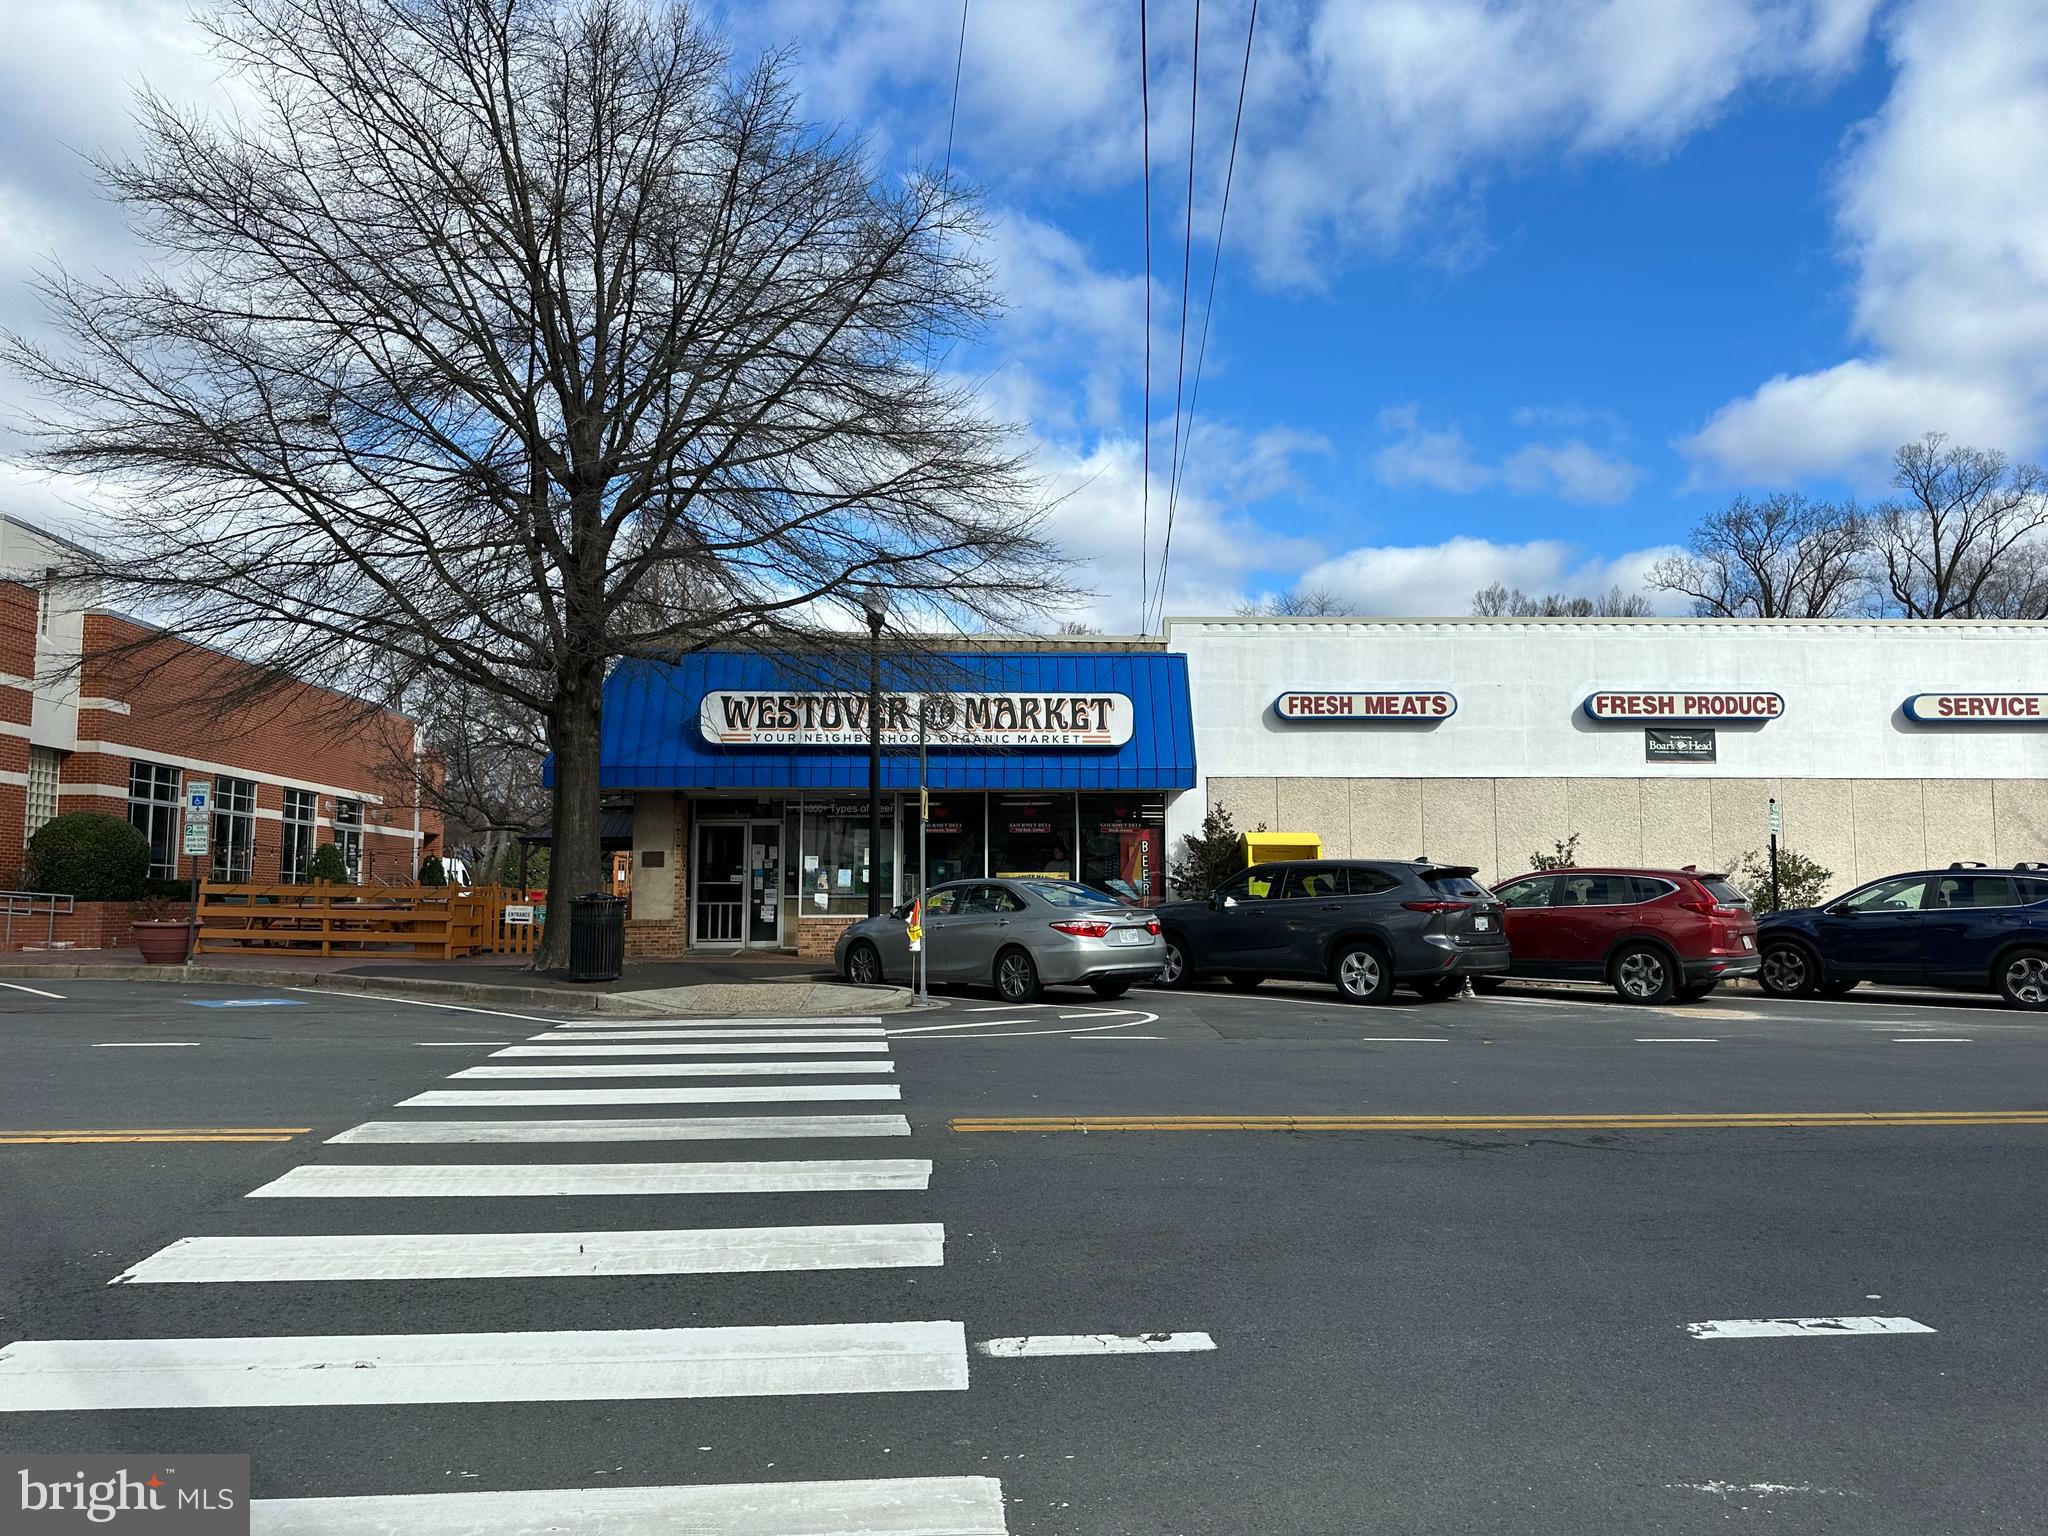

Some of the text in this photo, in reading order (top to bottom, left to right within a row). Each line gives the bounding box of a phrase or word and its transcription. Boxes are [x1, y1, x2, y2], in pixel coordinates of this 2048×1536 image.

[964, 697, 1113, 730] MARKET
[1288, 696, 1448, 715] FRESH MEATS
[1596, 696, 1779, 715] FRESH PRODUCE
[1938, 697, 2040, 716] SERVICE
[753, 734, 796, 742] YOUR
[939, 734, 1010, 743] ORGANIC
[1017, 735, 1081, 743] MARKET
[1689, 740, 1712, 750] Head
[830, 804, 858, 815] Types
[860, 803, 870, 813] of
[186, 825, 193, 835] 2
[1141, 840, 1149, 895] BEER
